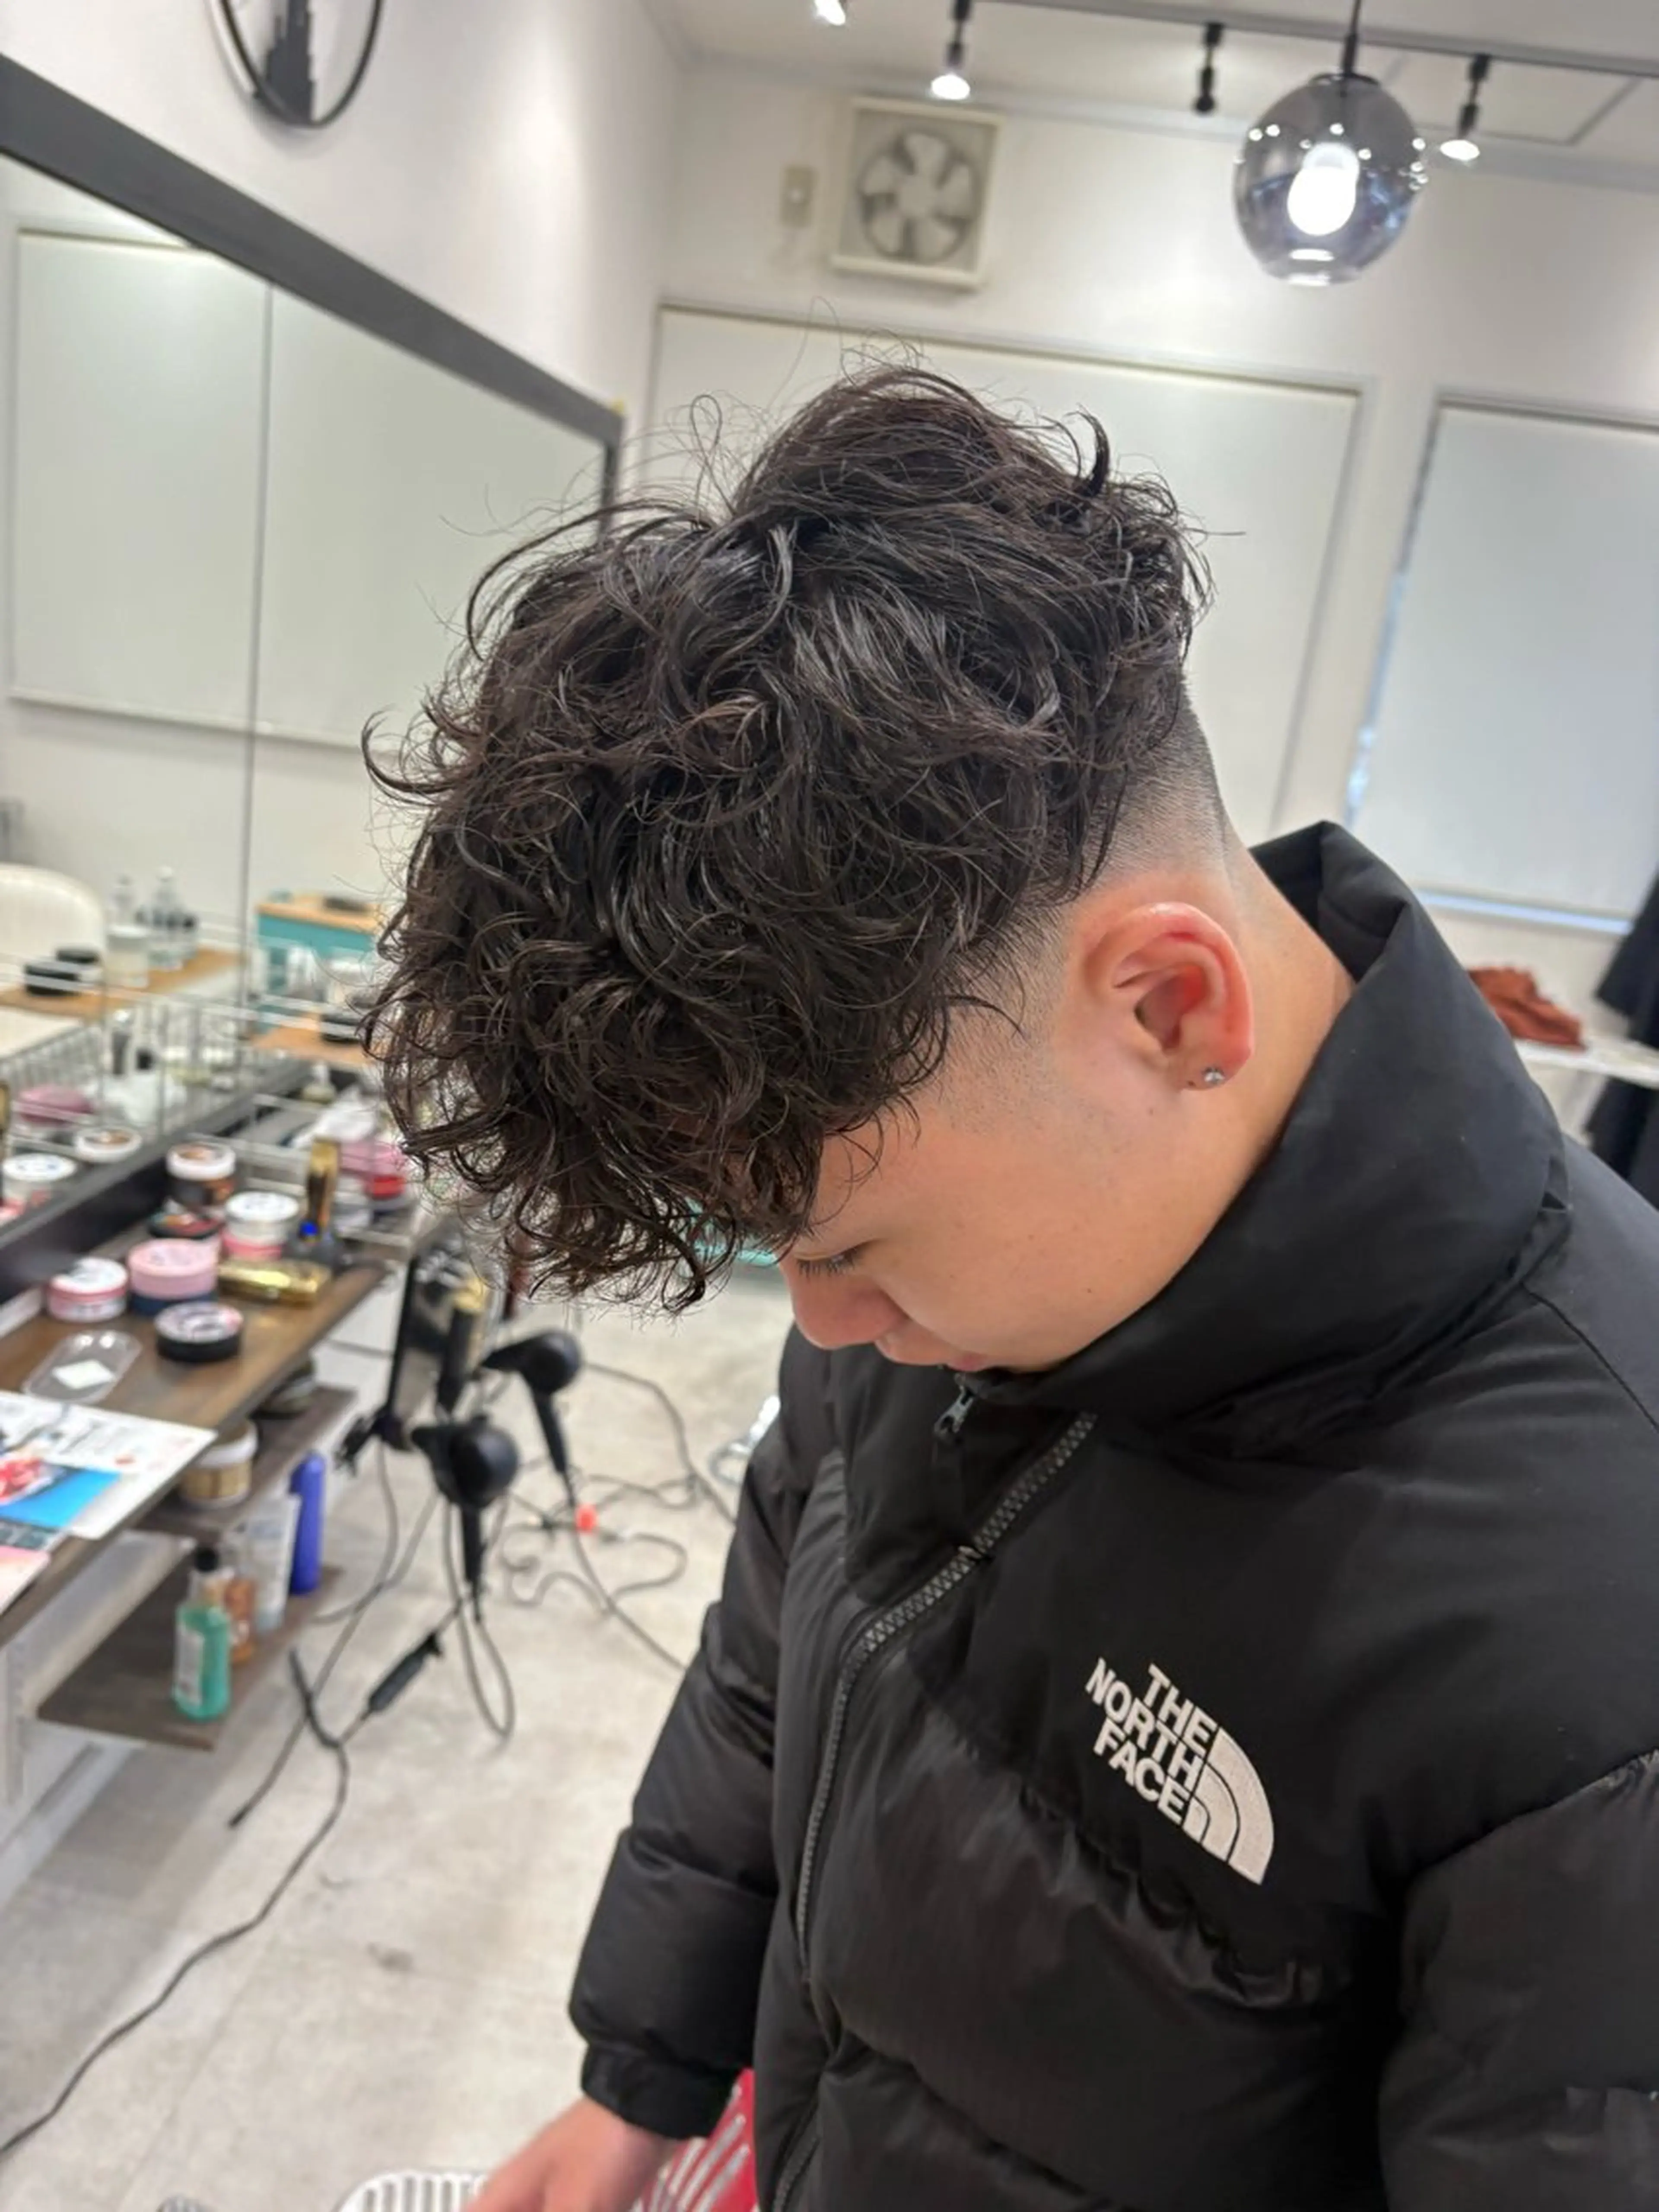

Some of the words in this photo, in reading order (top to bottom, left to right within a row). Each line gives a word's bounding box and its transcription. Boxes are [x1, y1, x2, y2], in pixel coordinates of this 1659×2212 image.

[1085, 1657, 1205, 1789] NORTH
[1144, 1663, 1218, 1758] THE
[1093, 1718, 1190, 1825] FACE
